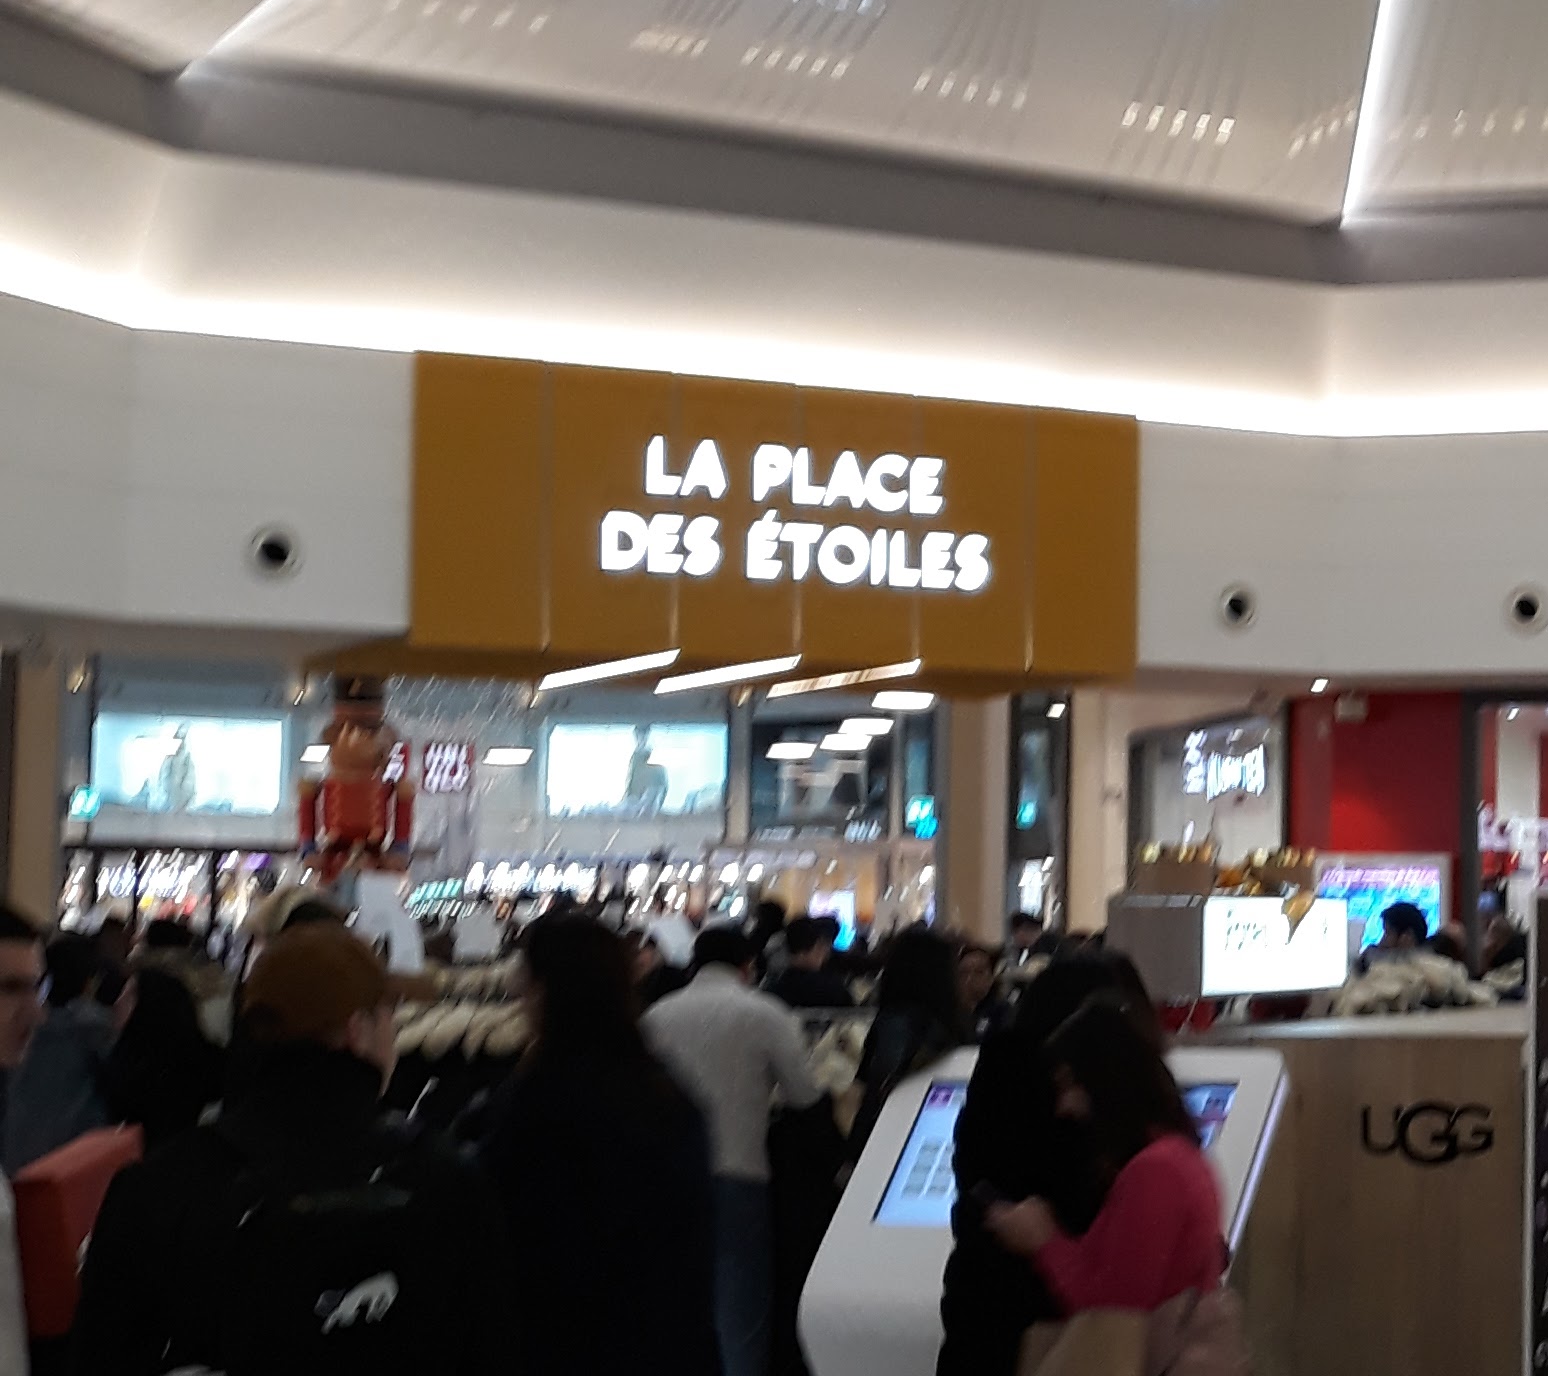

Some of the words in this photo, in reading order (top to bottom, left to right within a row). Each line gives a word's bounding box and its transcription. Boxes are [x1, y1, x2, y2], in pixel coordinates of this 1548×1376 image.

[645, 433, 728, 500] LA
[751, 442, 947, 516] PLACE
[600, 508, 723, 577] DES
[744, 508, 993, 593] ÉTOILES
[1361, 1099, 1494, 1165] UGG
